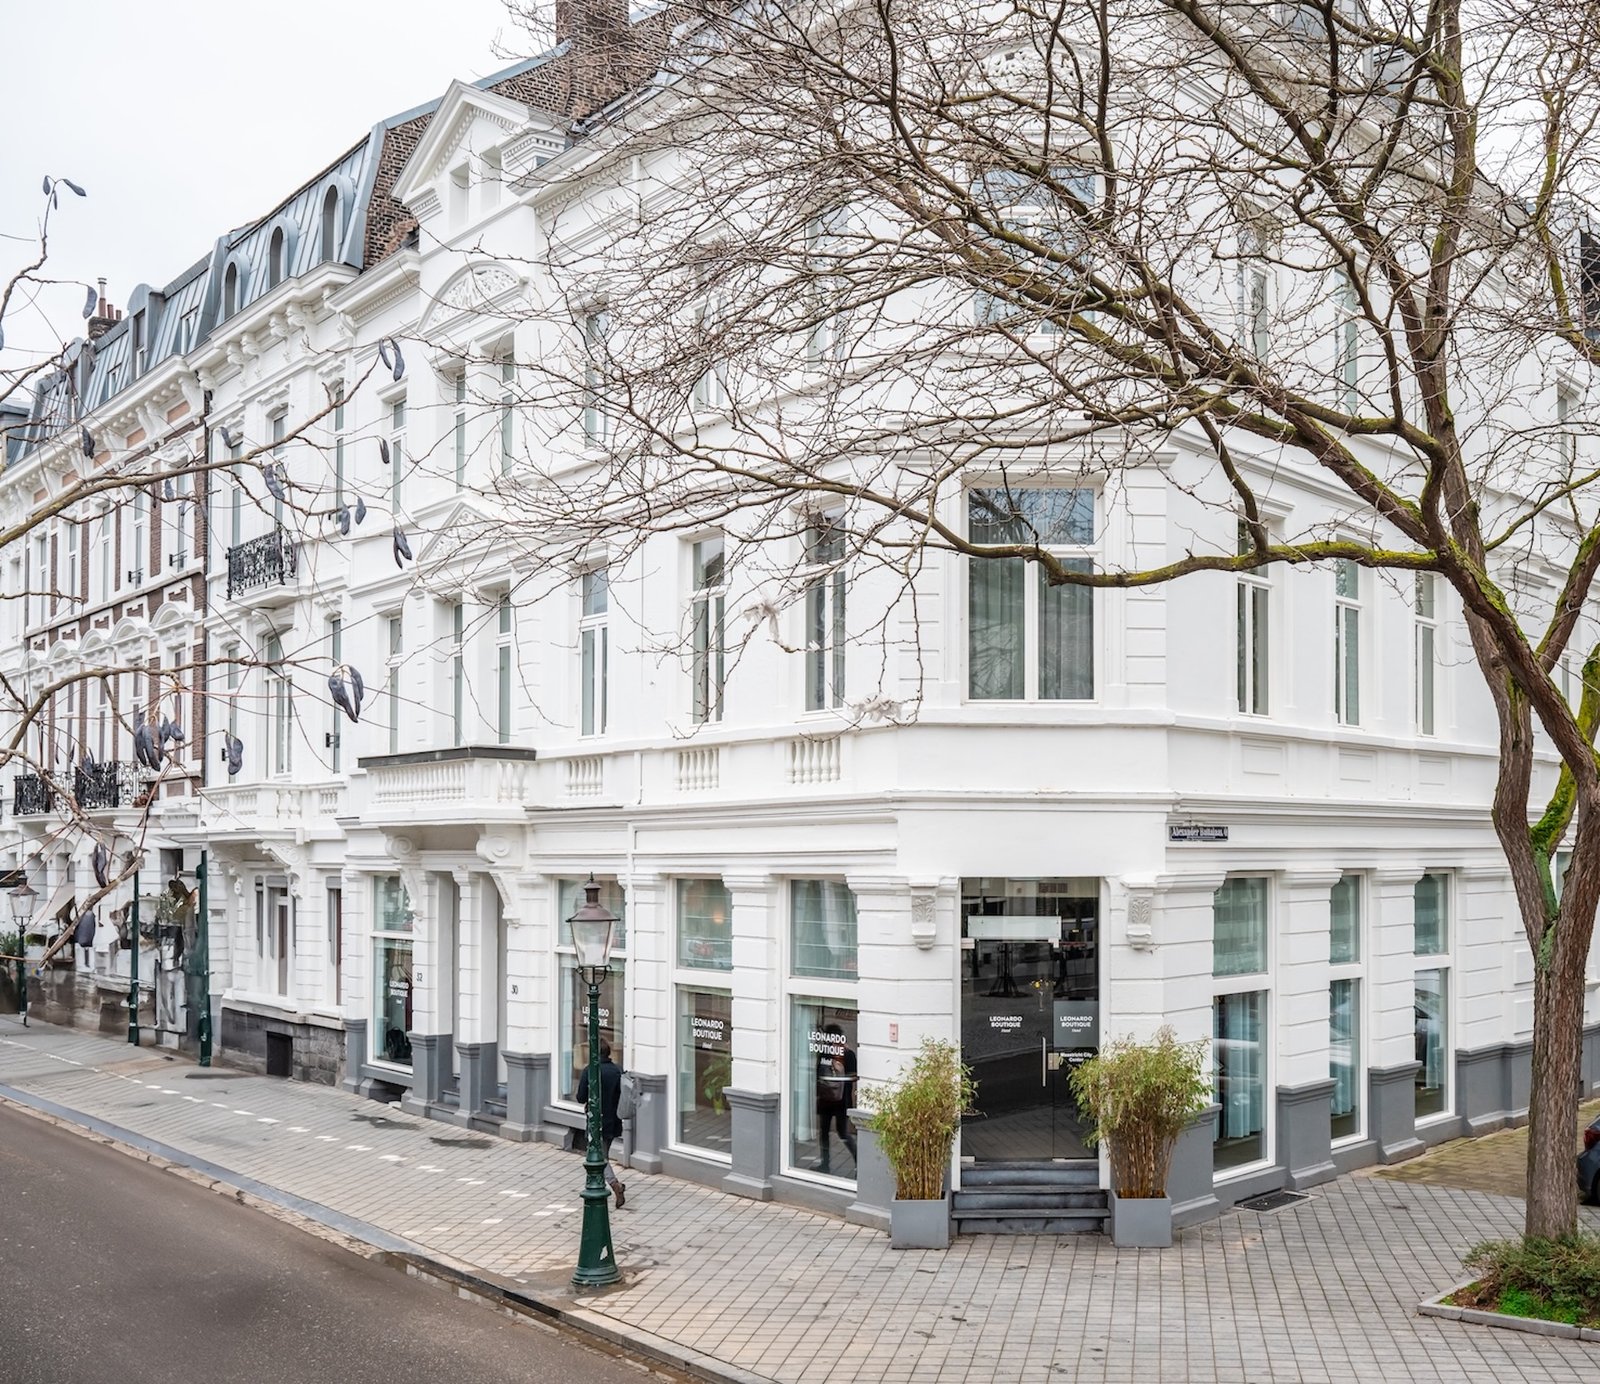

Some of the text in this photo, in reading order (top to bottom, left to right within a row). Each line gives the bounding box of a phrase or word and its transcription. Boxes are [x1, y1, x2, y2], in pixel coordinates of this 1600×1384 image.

[691, 1017, 724, 1029] LEONARDO
[692, 1028, 722, 1041] BOUTIQUE
[807, 1031, 846, 1045] LEONARDO
[809, 1043, 844, 1057] BOUTIQUE
